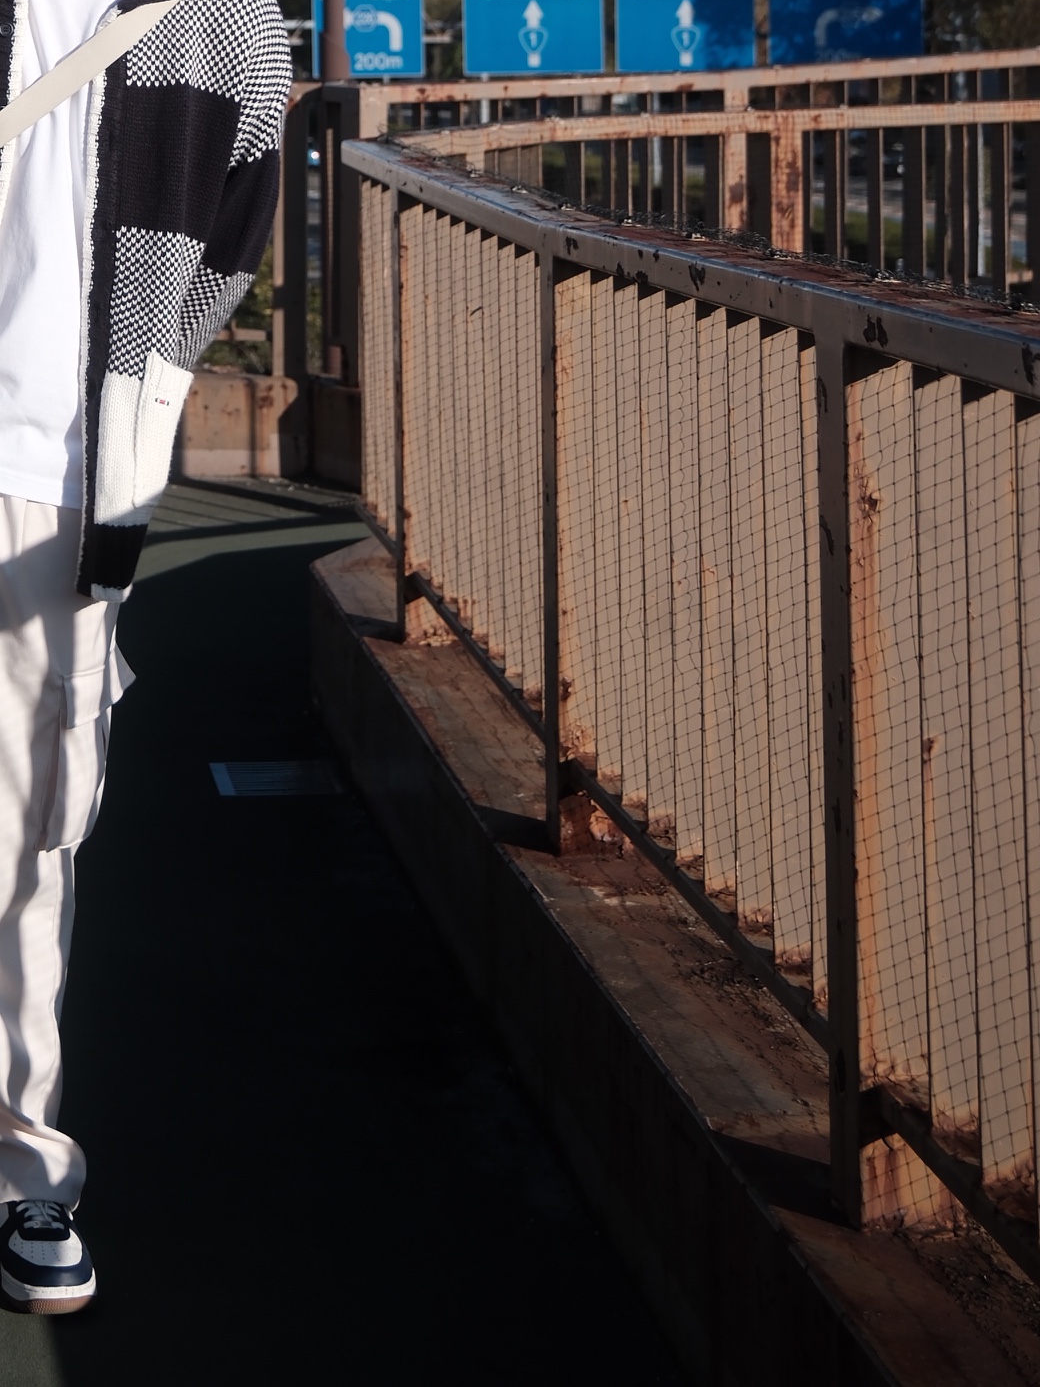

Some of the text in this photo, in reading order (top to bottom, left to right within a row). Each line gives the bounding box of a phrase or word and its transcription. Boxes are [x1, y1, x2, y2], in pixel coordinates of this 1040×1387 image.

[529, 31, 538, 47] 1
[681, 31, 690, 47] 1
[354, 51, 404, 71] 200m
